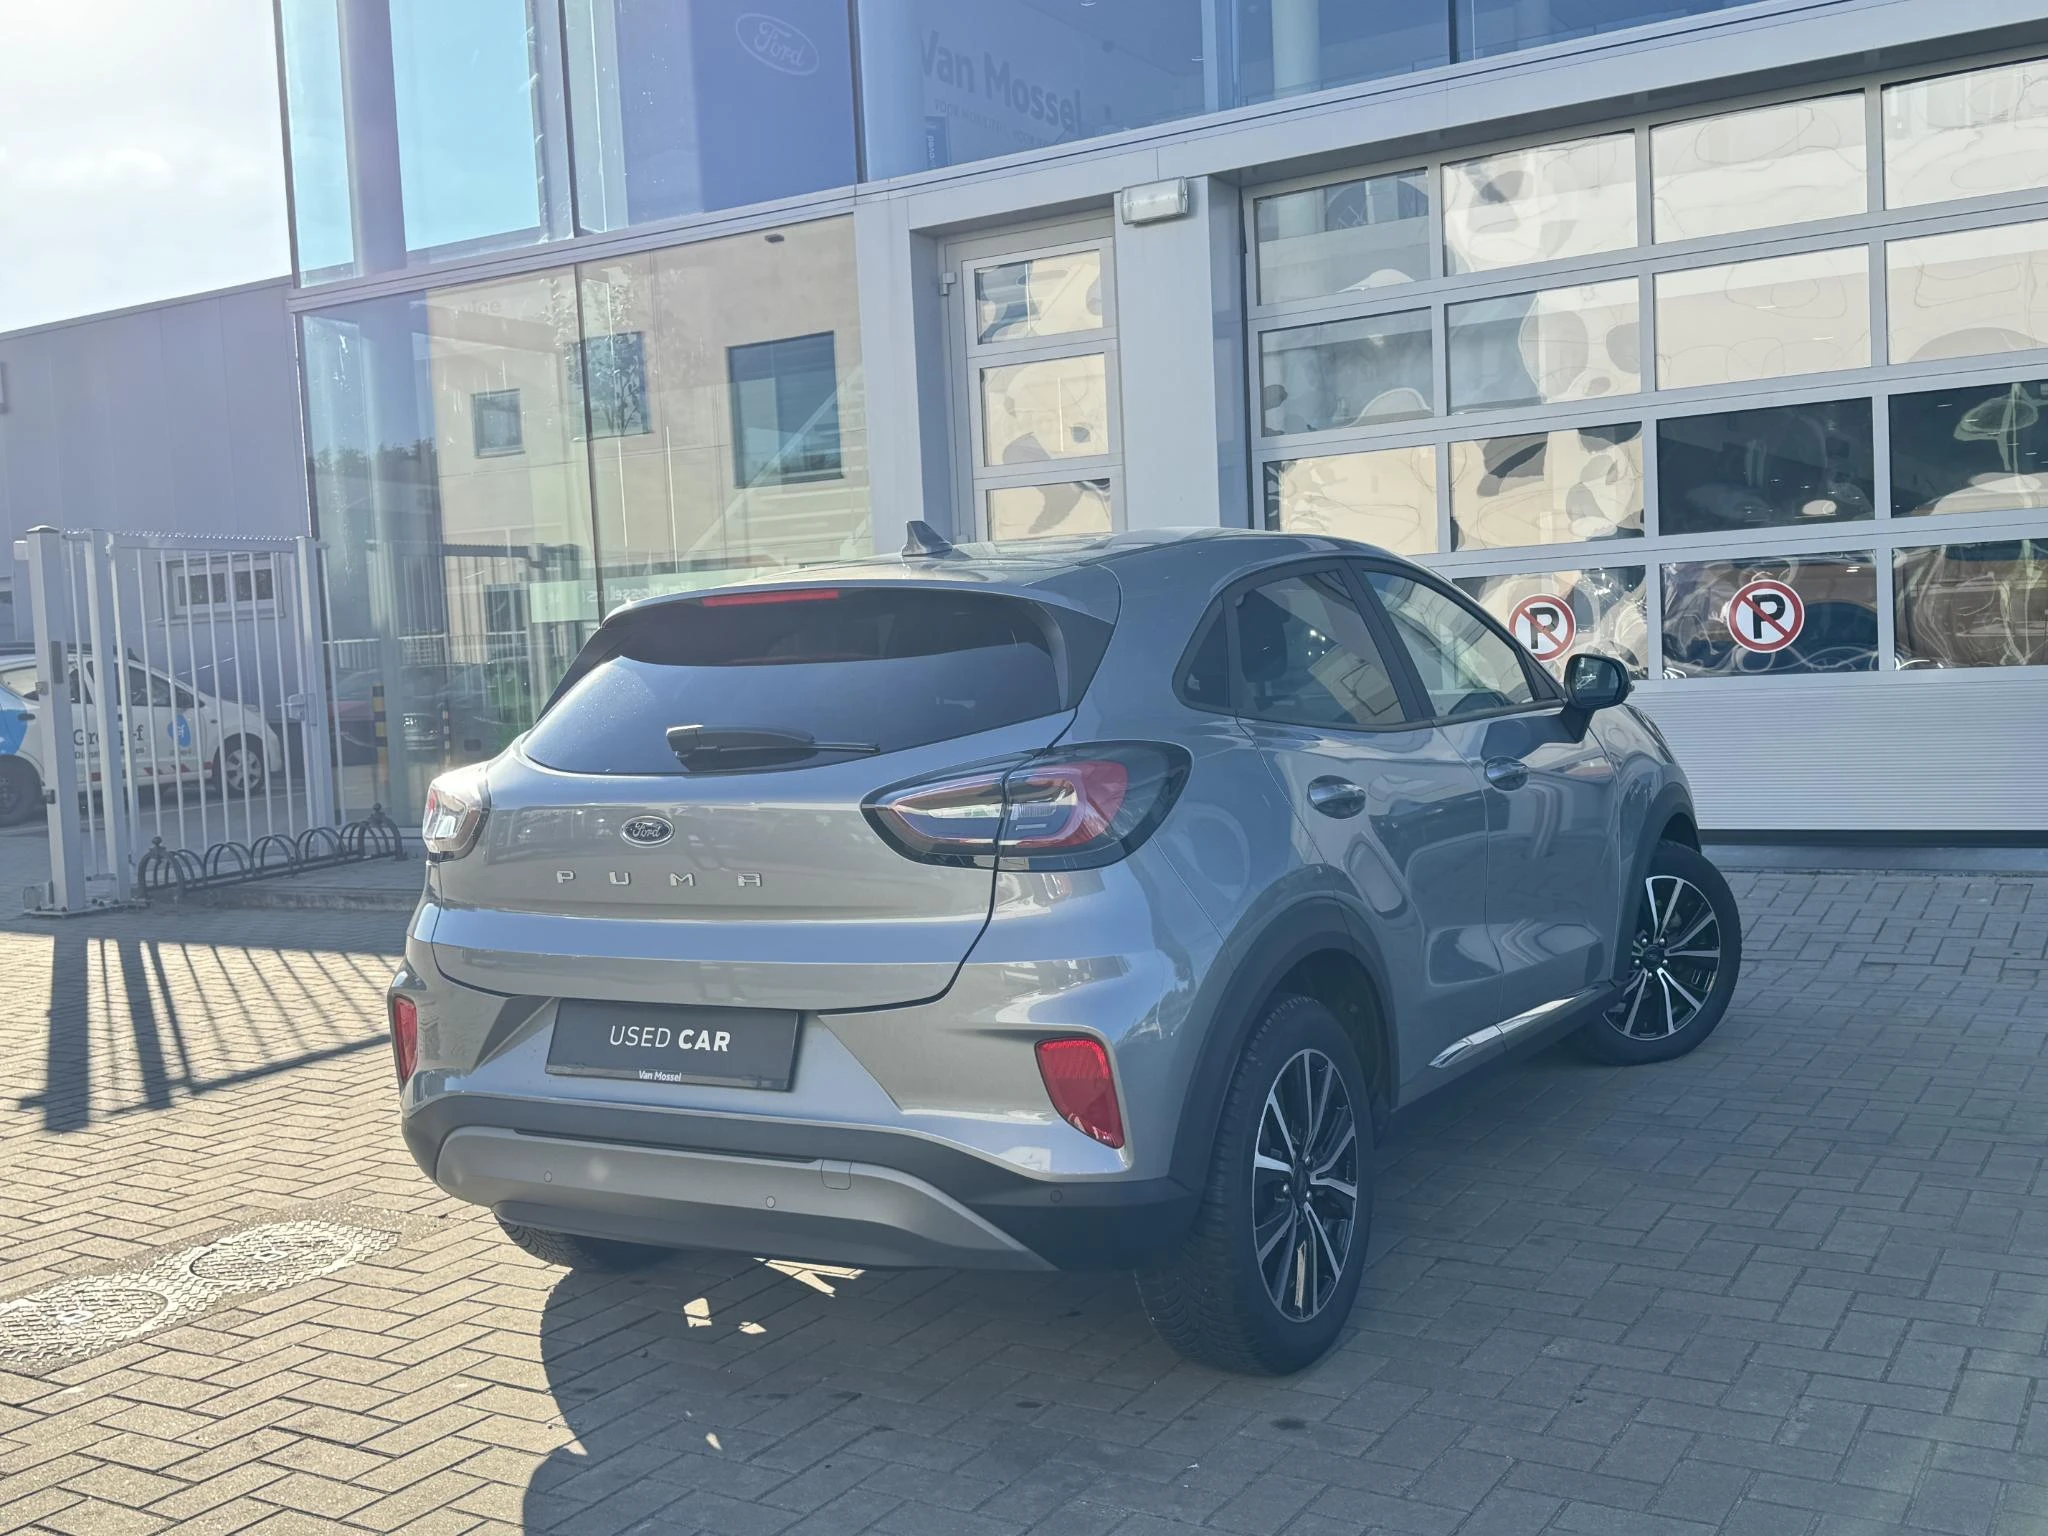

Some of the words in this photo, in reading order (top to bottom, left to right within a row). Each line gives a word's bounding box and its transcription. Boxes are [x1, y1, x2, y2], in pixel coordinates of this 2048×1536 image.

[920, 28, 975, 93] Van
[984, 51, 1081, 137] Mossel
[1529, 606, 1560, 650] P
[1752, 594, 1785, 640] P
[556, 870, 762, 888] PUMA
[609, 1025, 671, 1048] USED
[677, 1028, 731, 1052] CAR
[638, 1070, 653, 1080] Van
[653, 1071, 682, 1082] Mossel
